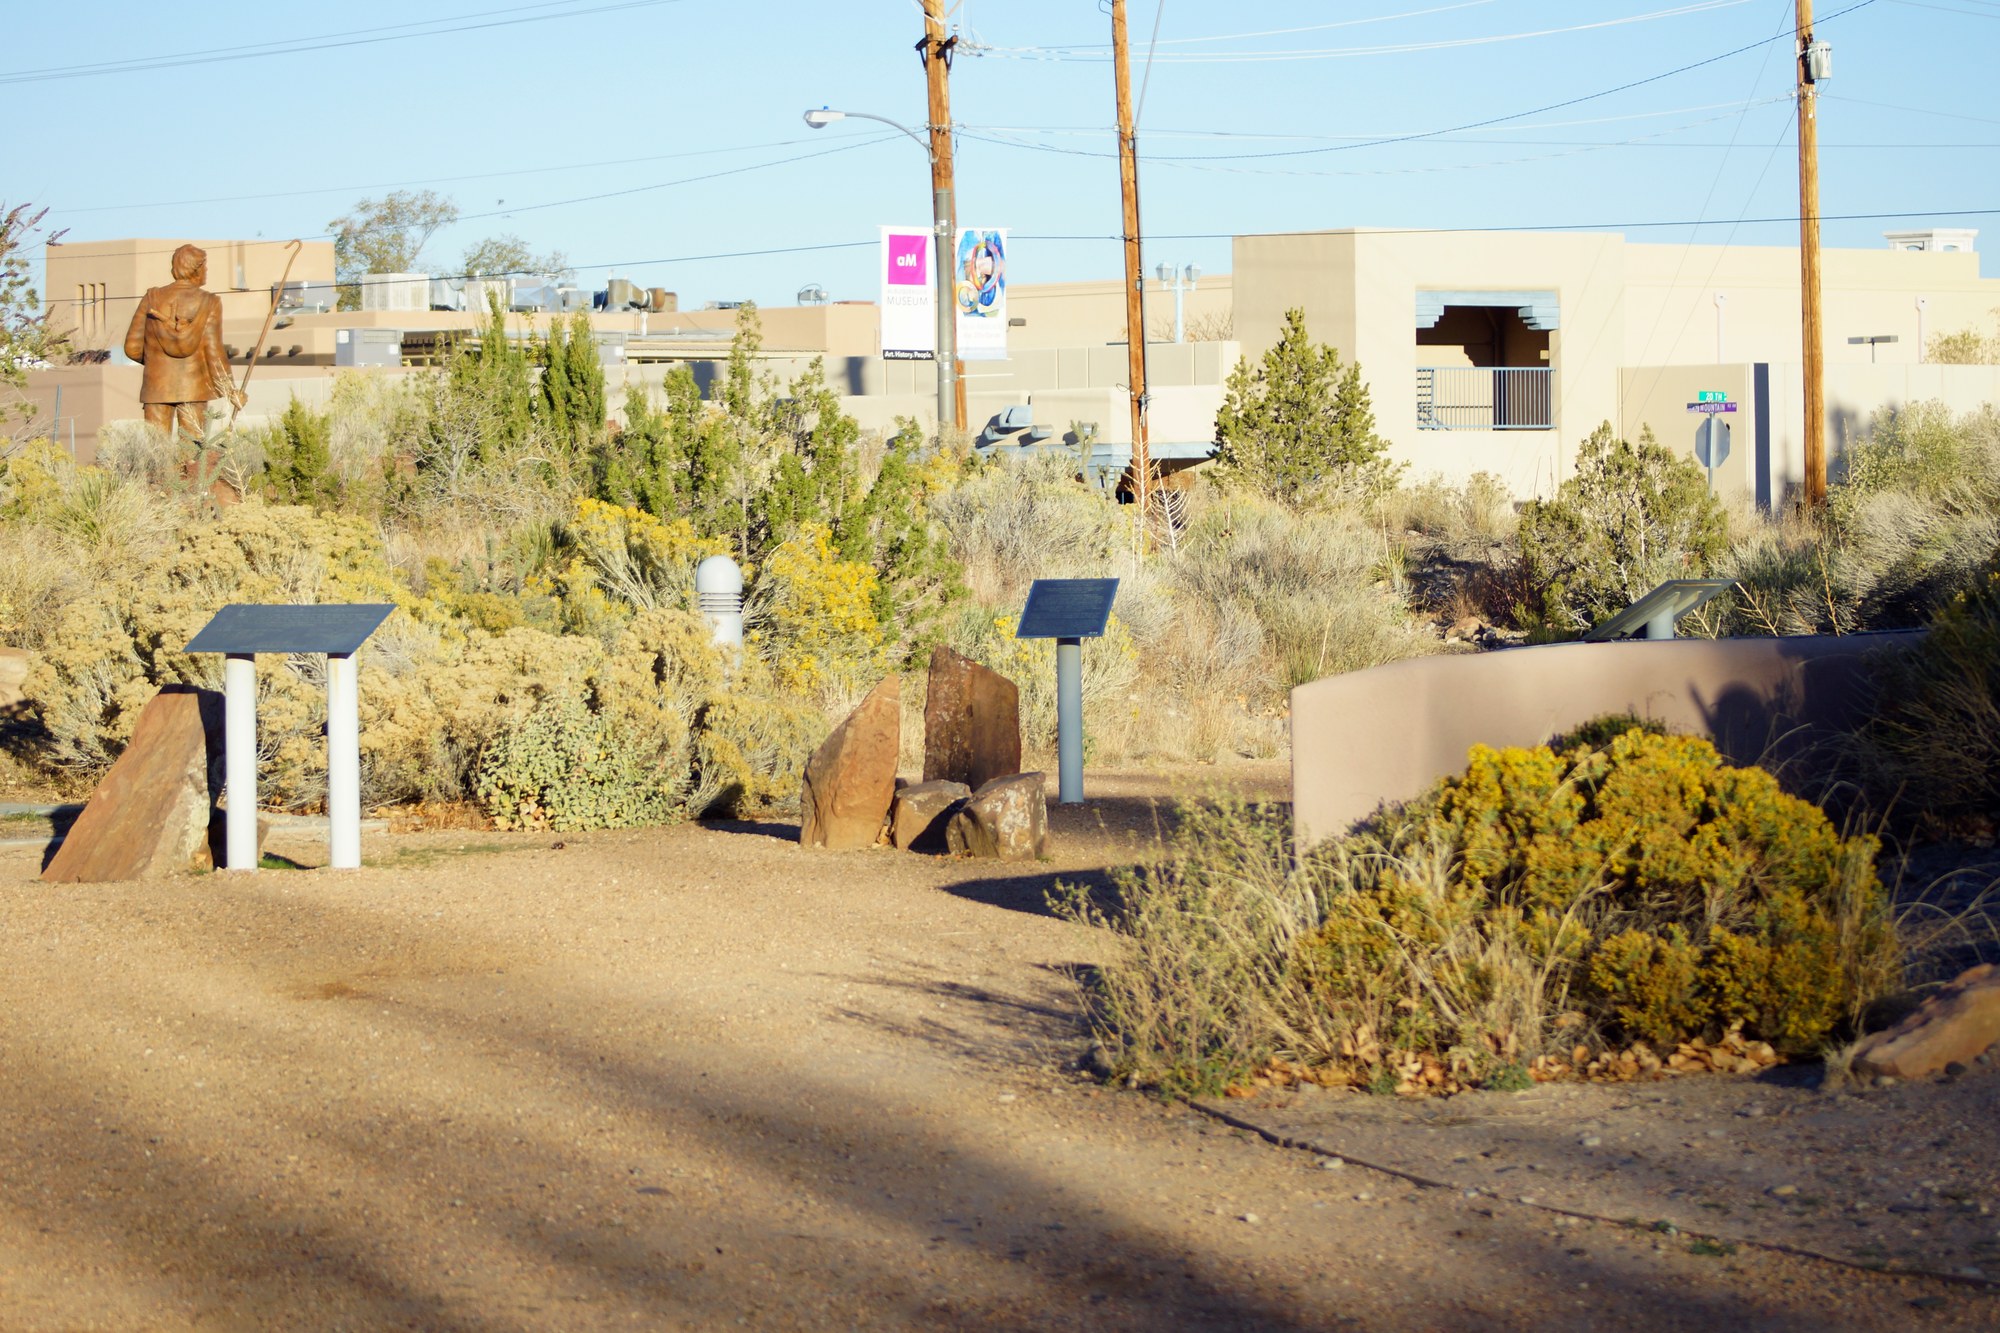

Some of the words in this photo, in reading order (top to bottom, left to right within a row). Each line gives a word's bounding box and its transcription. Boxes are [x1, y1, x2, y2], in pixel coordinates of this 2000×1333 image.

[896, 253, 917, 267] aM
[887, 296, 928, 306] MUSEUM
[1706, 392, 1714, 401] 20
